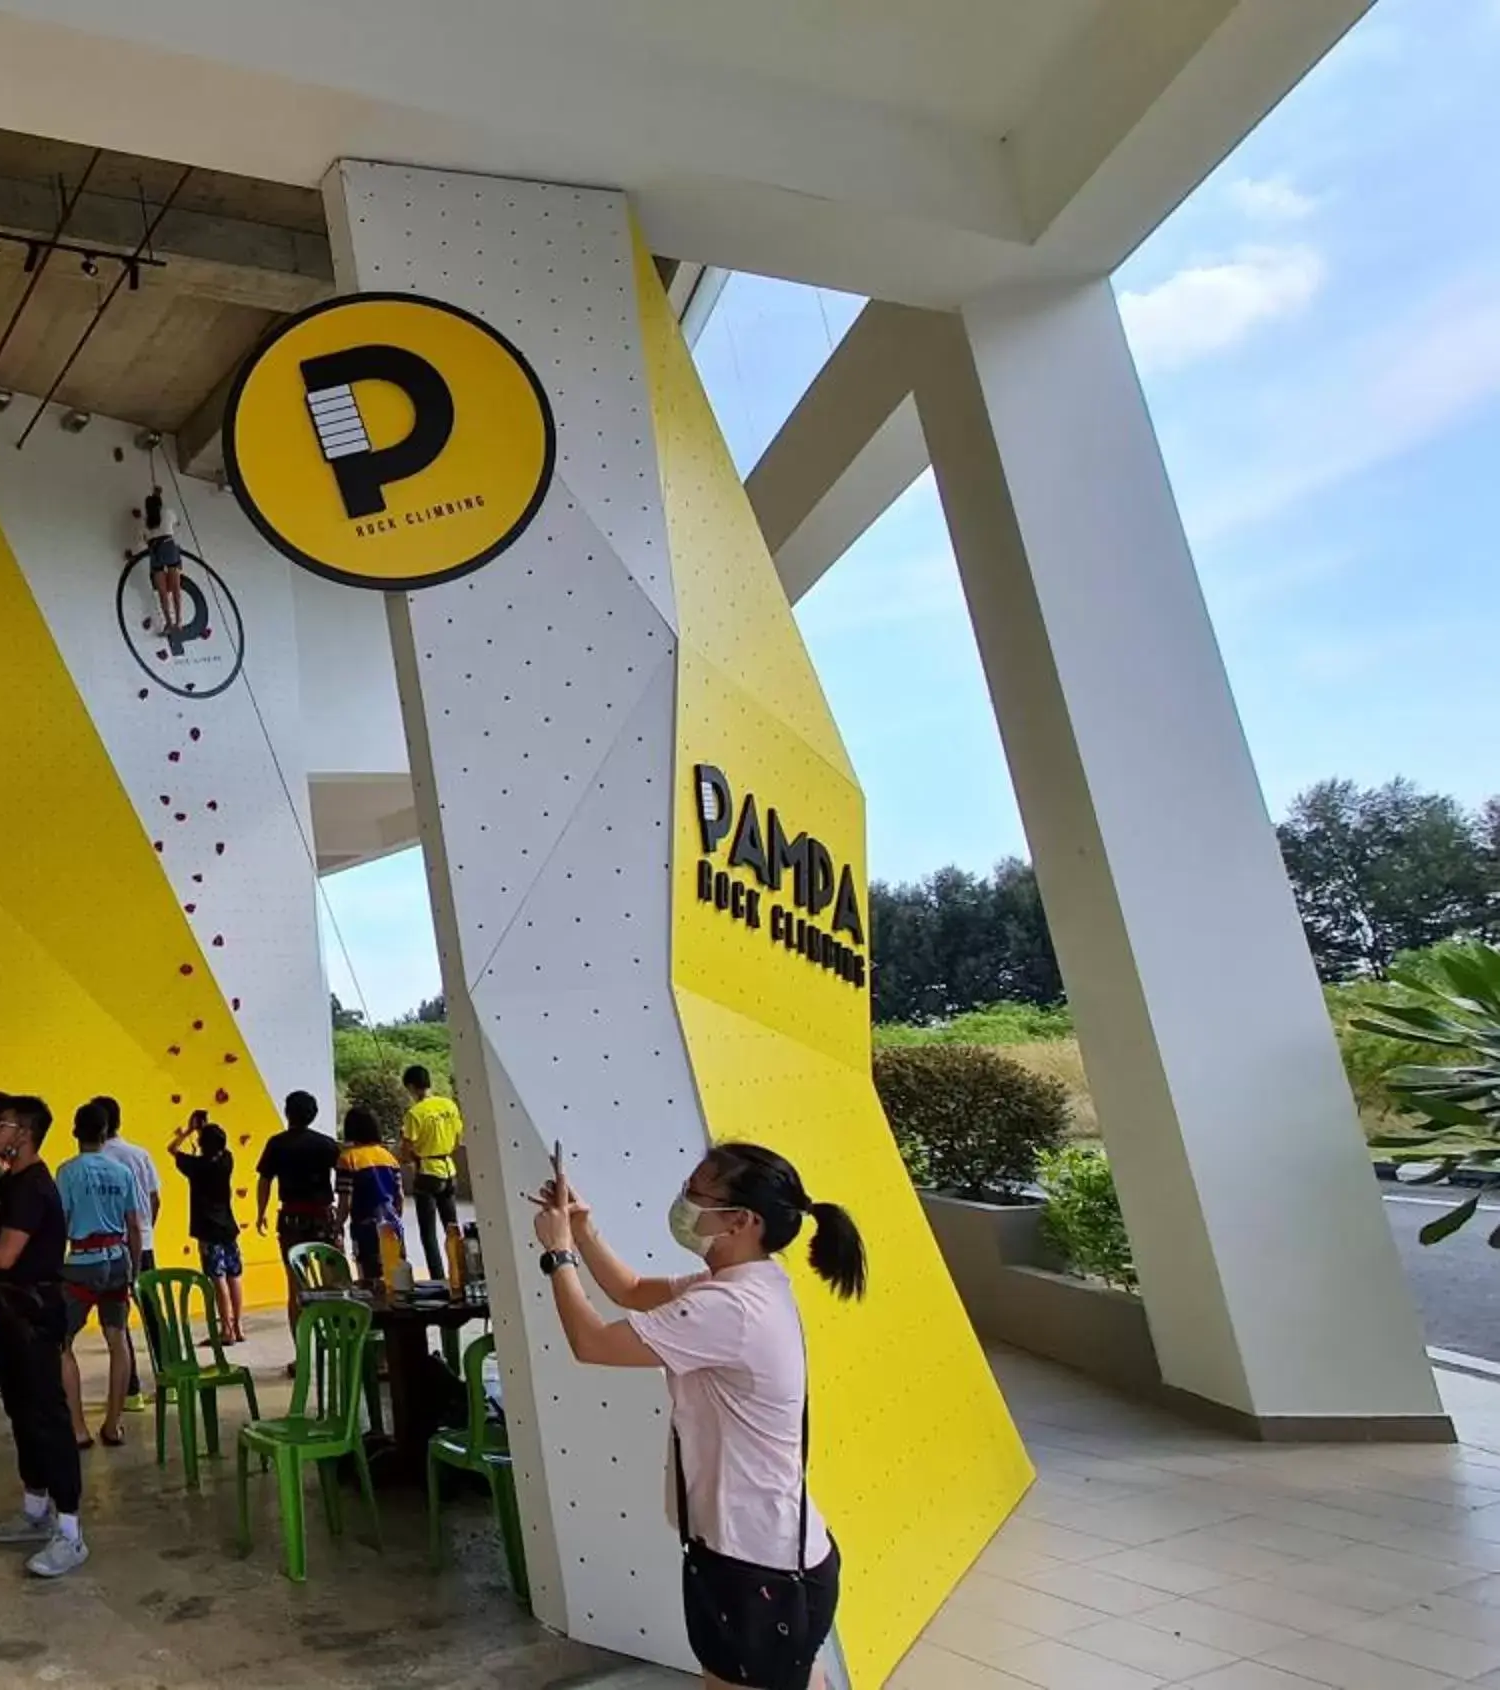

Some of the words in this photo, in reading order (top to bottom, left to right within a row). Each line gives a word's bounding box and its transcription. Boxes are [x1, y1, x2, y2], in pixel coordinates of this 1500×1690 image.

[300, 344, 455, 519] P
[355, 518, 398, 538] ROCK
[405, 494, 486, 527] CLIMBING
[694, 763, 865, 946] PAMPA
[697, 858, 761, 930] ROCK
[770, 904, 866, 989] CLIMBING
